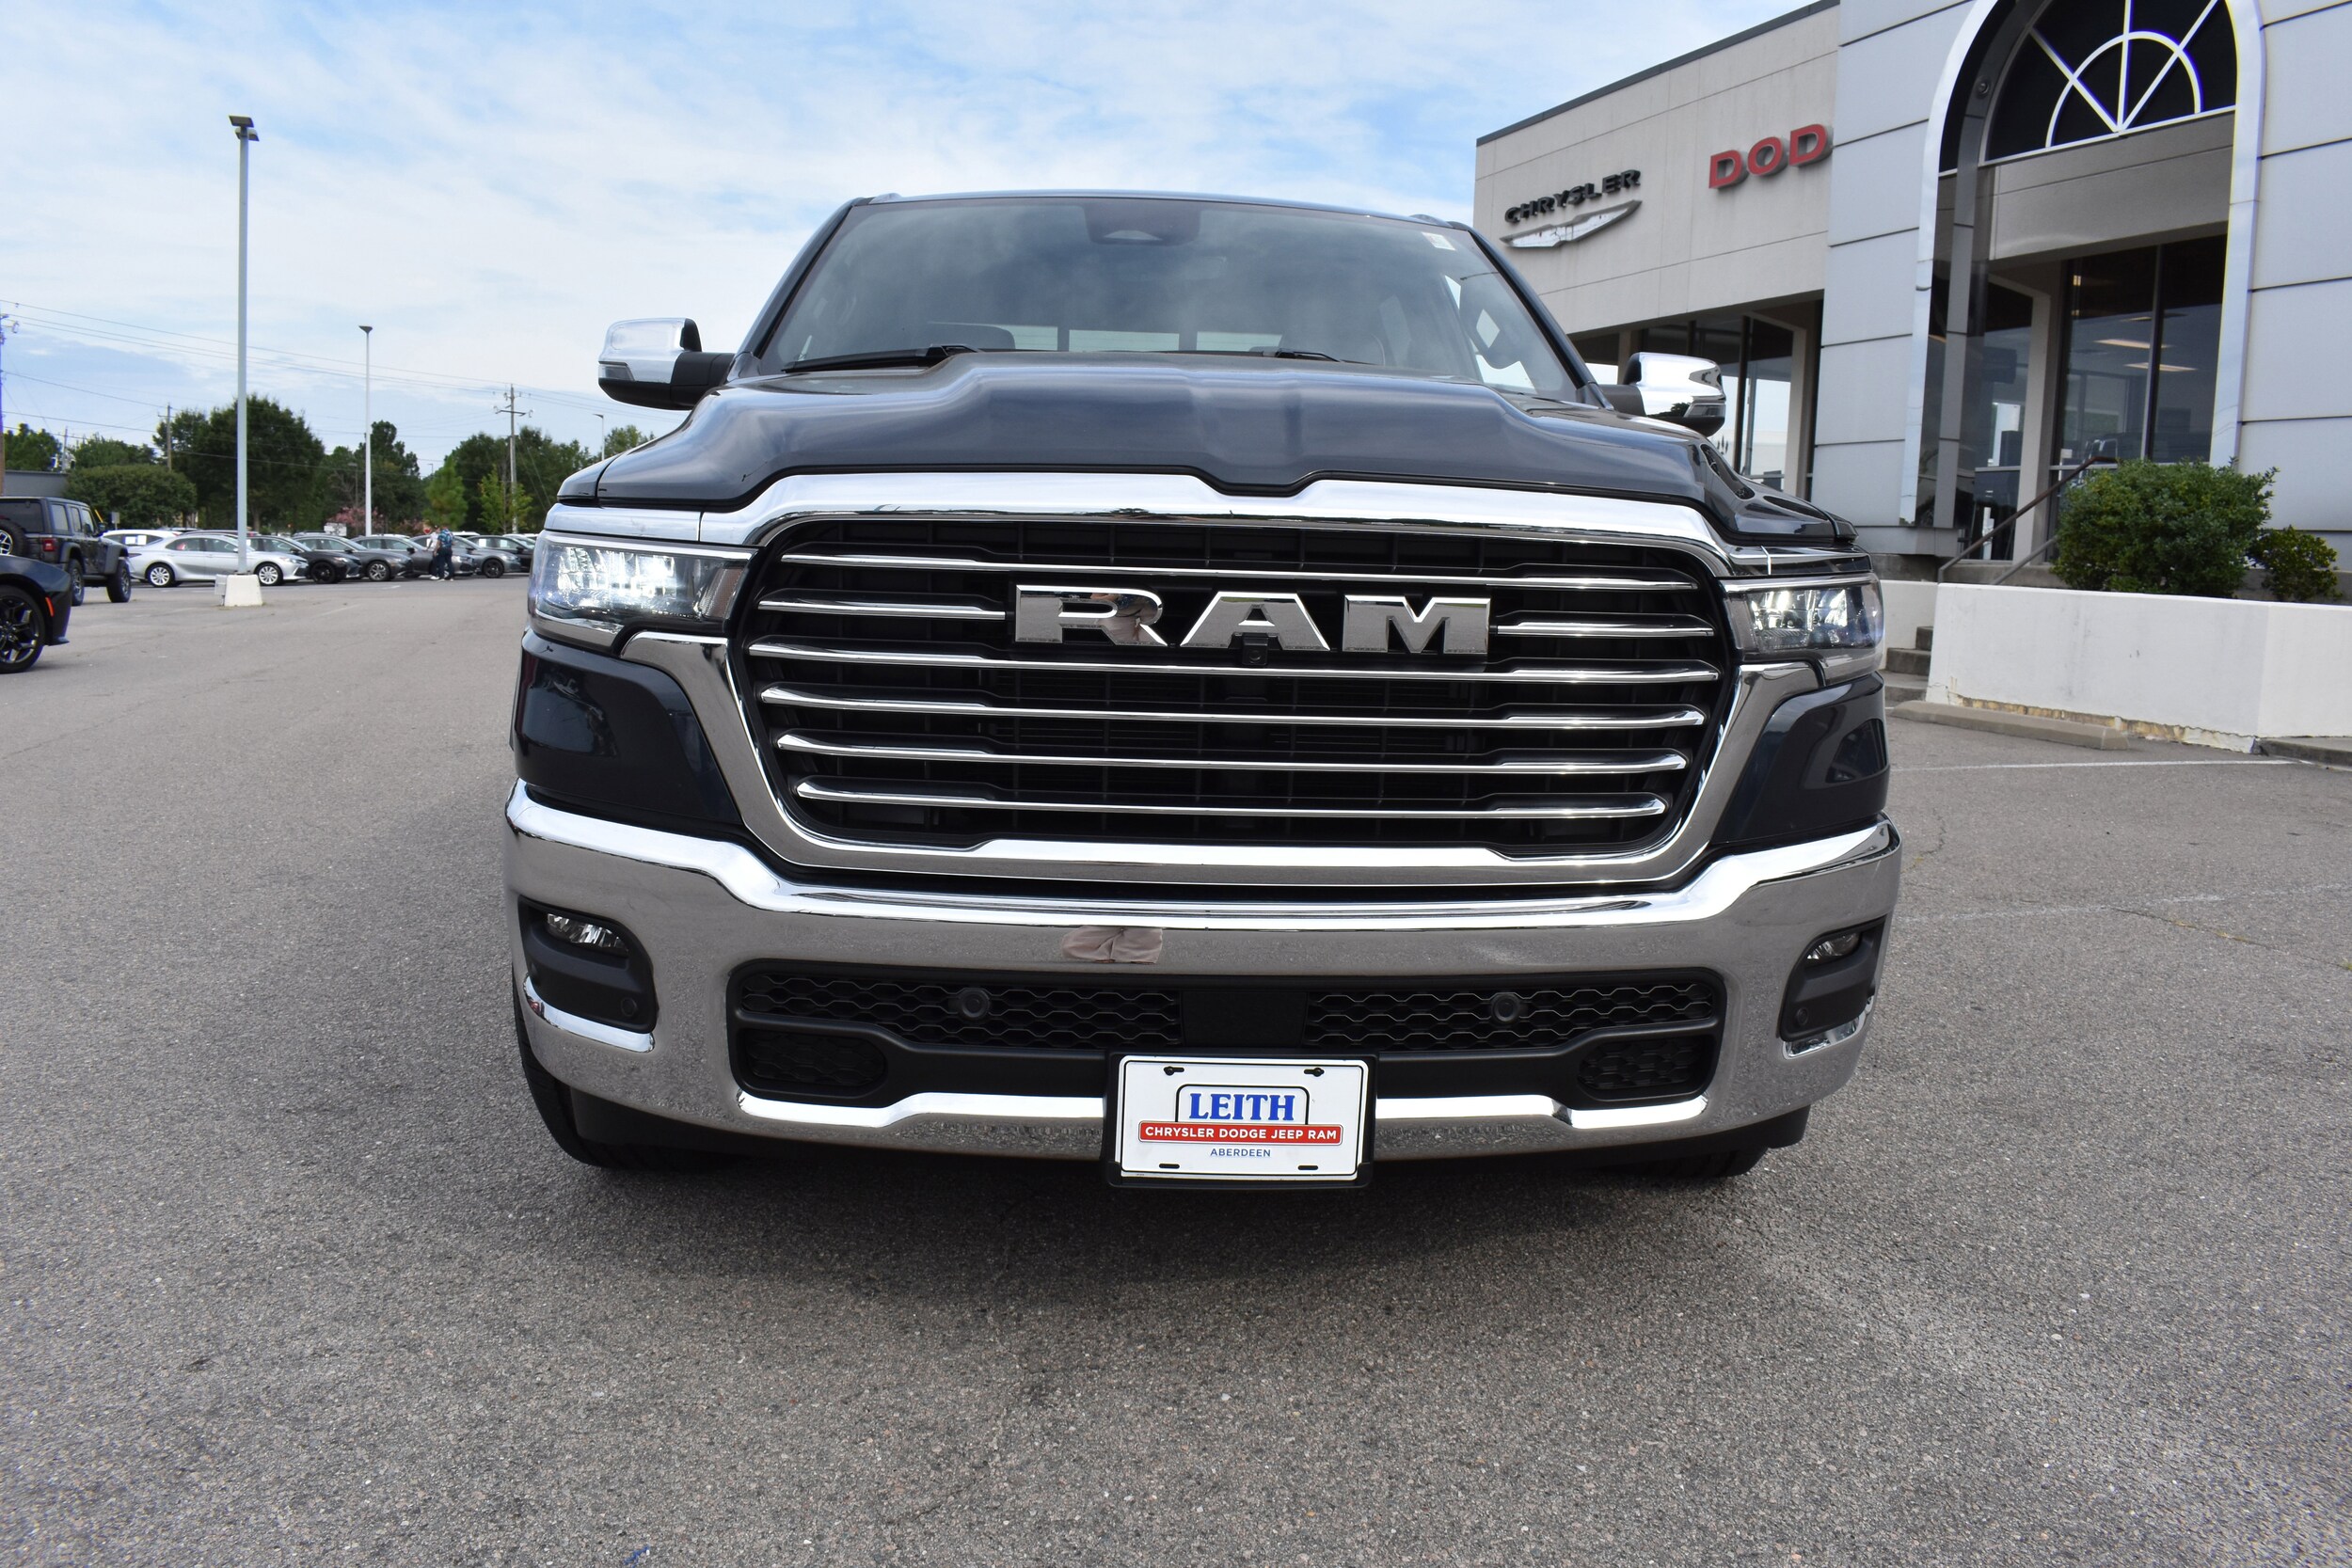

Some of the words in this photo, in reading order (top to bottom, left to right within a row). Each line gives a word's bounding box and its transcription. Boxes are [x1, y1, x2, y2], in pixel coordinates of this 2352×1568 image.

[1504, 169, 1642, 224] CHRYSLER
[1016, 584, 1492, 655] RAM
[1189, 1094, 1295, 1120] LEITH
[1145, 1127, 1215, 1138] CHRYSLER
[1219, 1129, 1266, 1139] DODGE
[1271, 1130, 1304, 1140] JEEP
[1308, 1131, 1337, 1140] RAM
[1210, 1148, 1271, 1158] ABERDEEN
